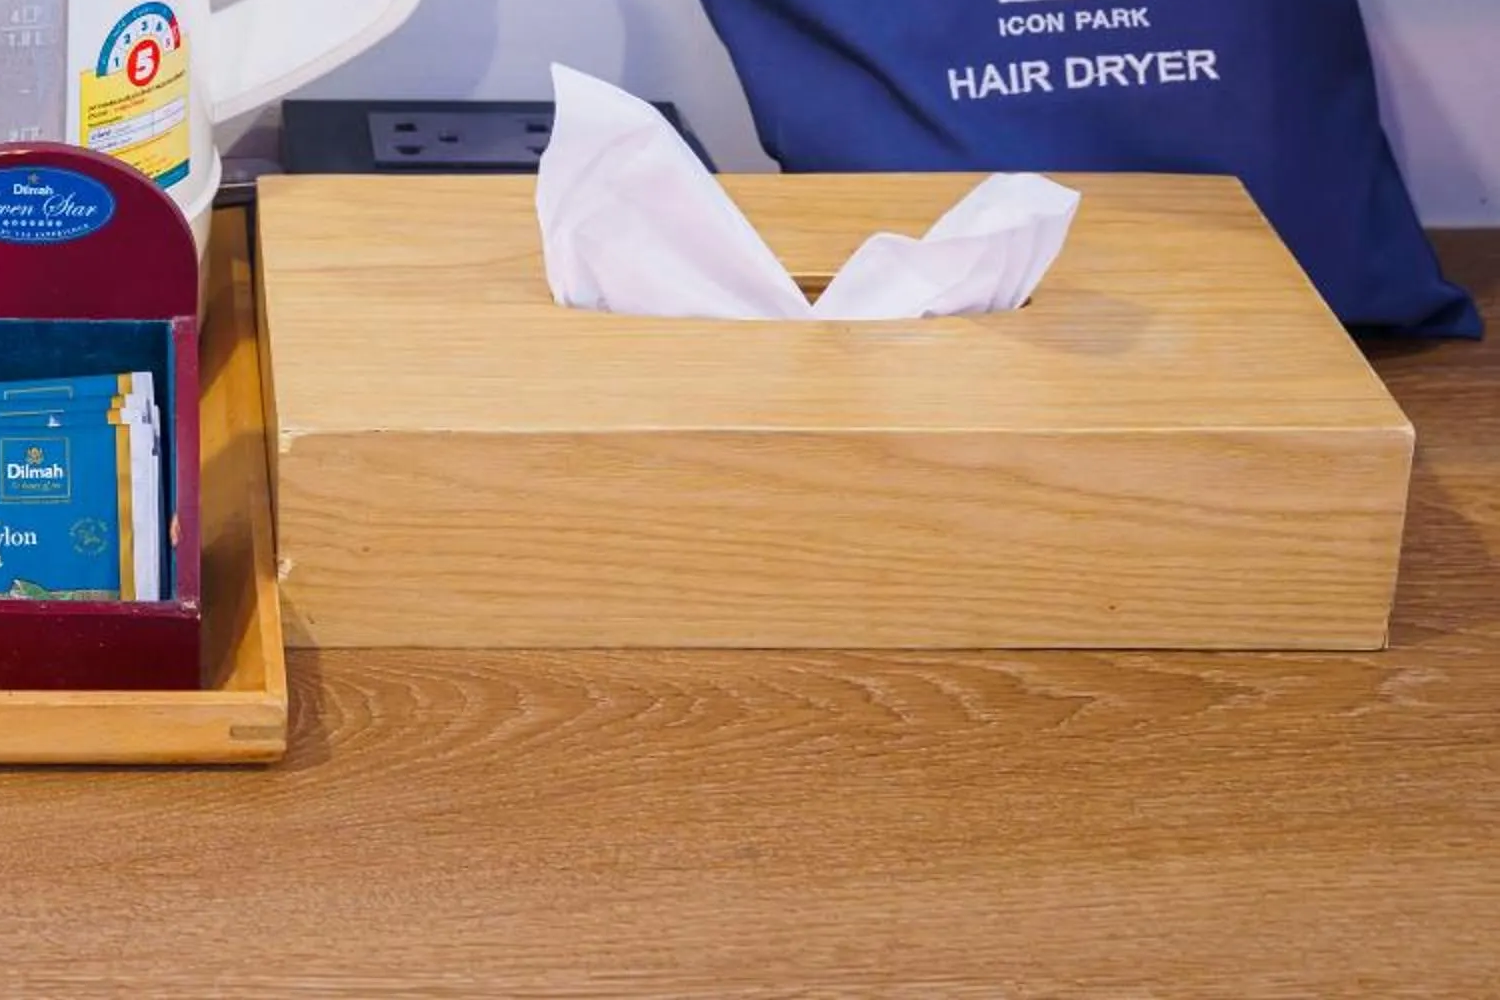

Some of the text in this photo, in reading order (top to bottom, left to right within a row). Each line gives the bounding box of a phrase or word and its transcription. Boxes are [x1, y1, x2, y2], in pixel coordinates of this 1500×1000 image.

[999, 7, 1150, 37] ICON PARK
[134, 46, 155, 81] 5
[947, 48, 1221, 100] HAIR DRYER
[43, 191, 98, 222] Star
[7, 463, 64, 479] Dilmah
